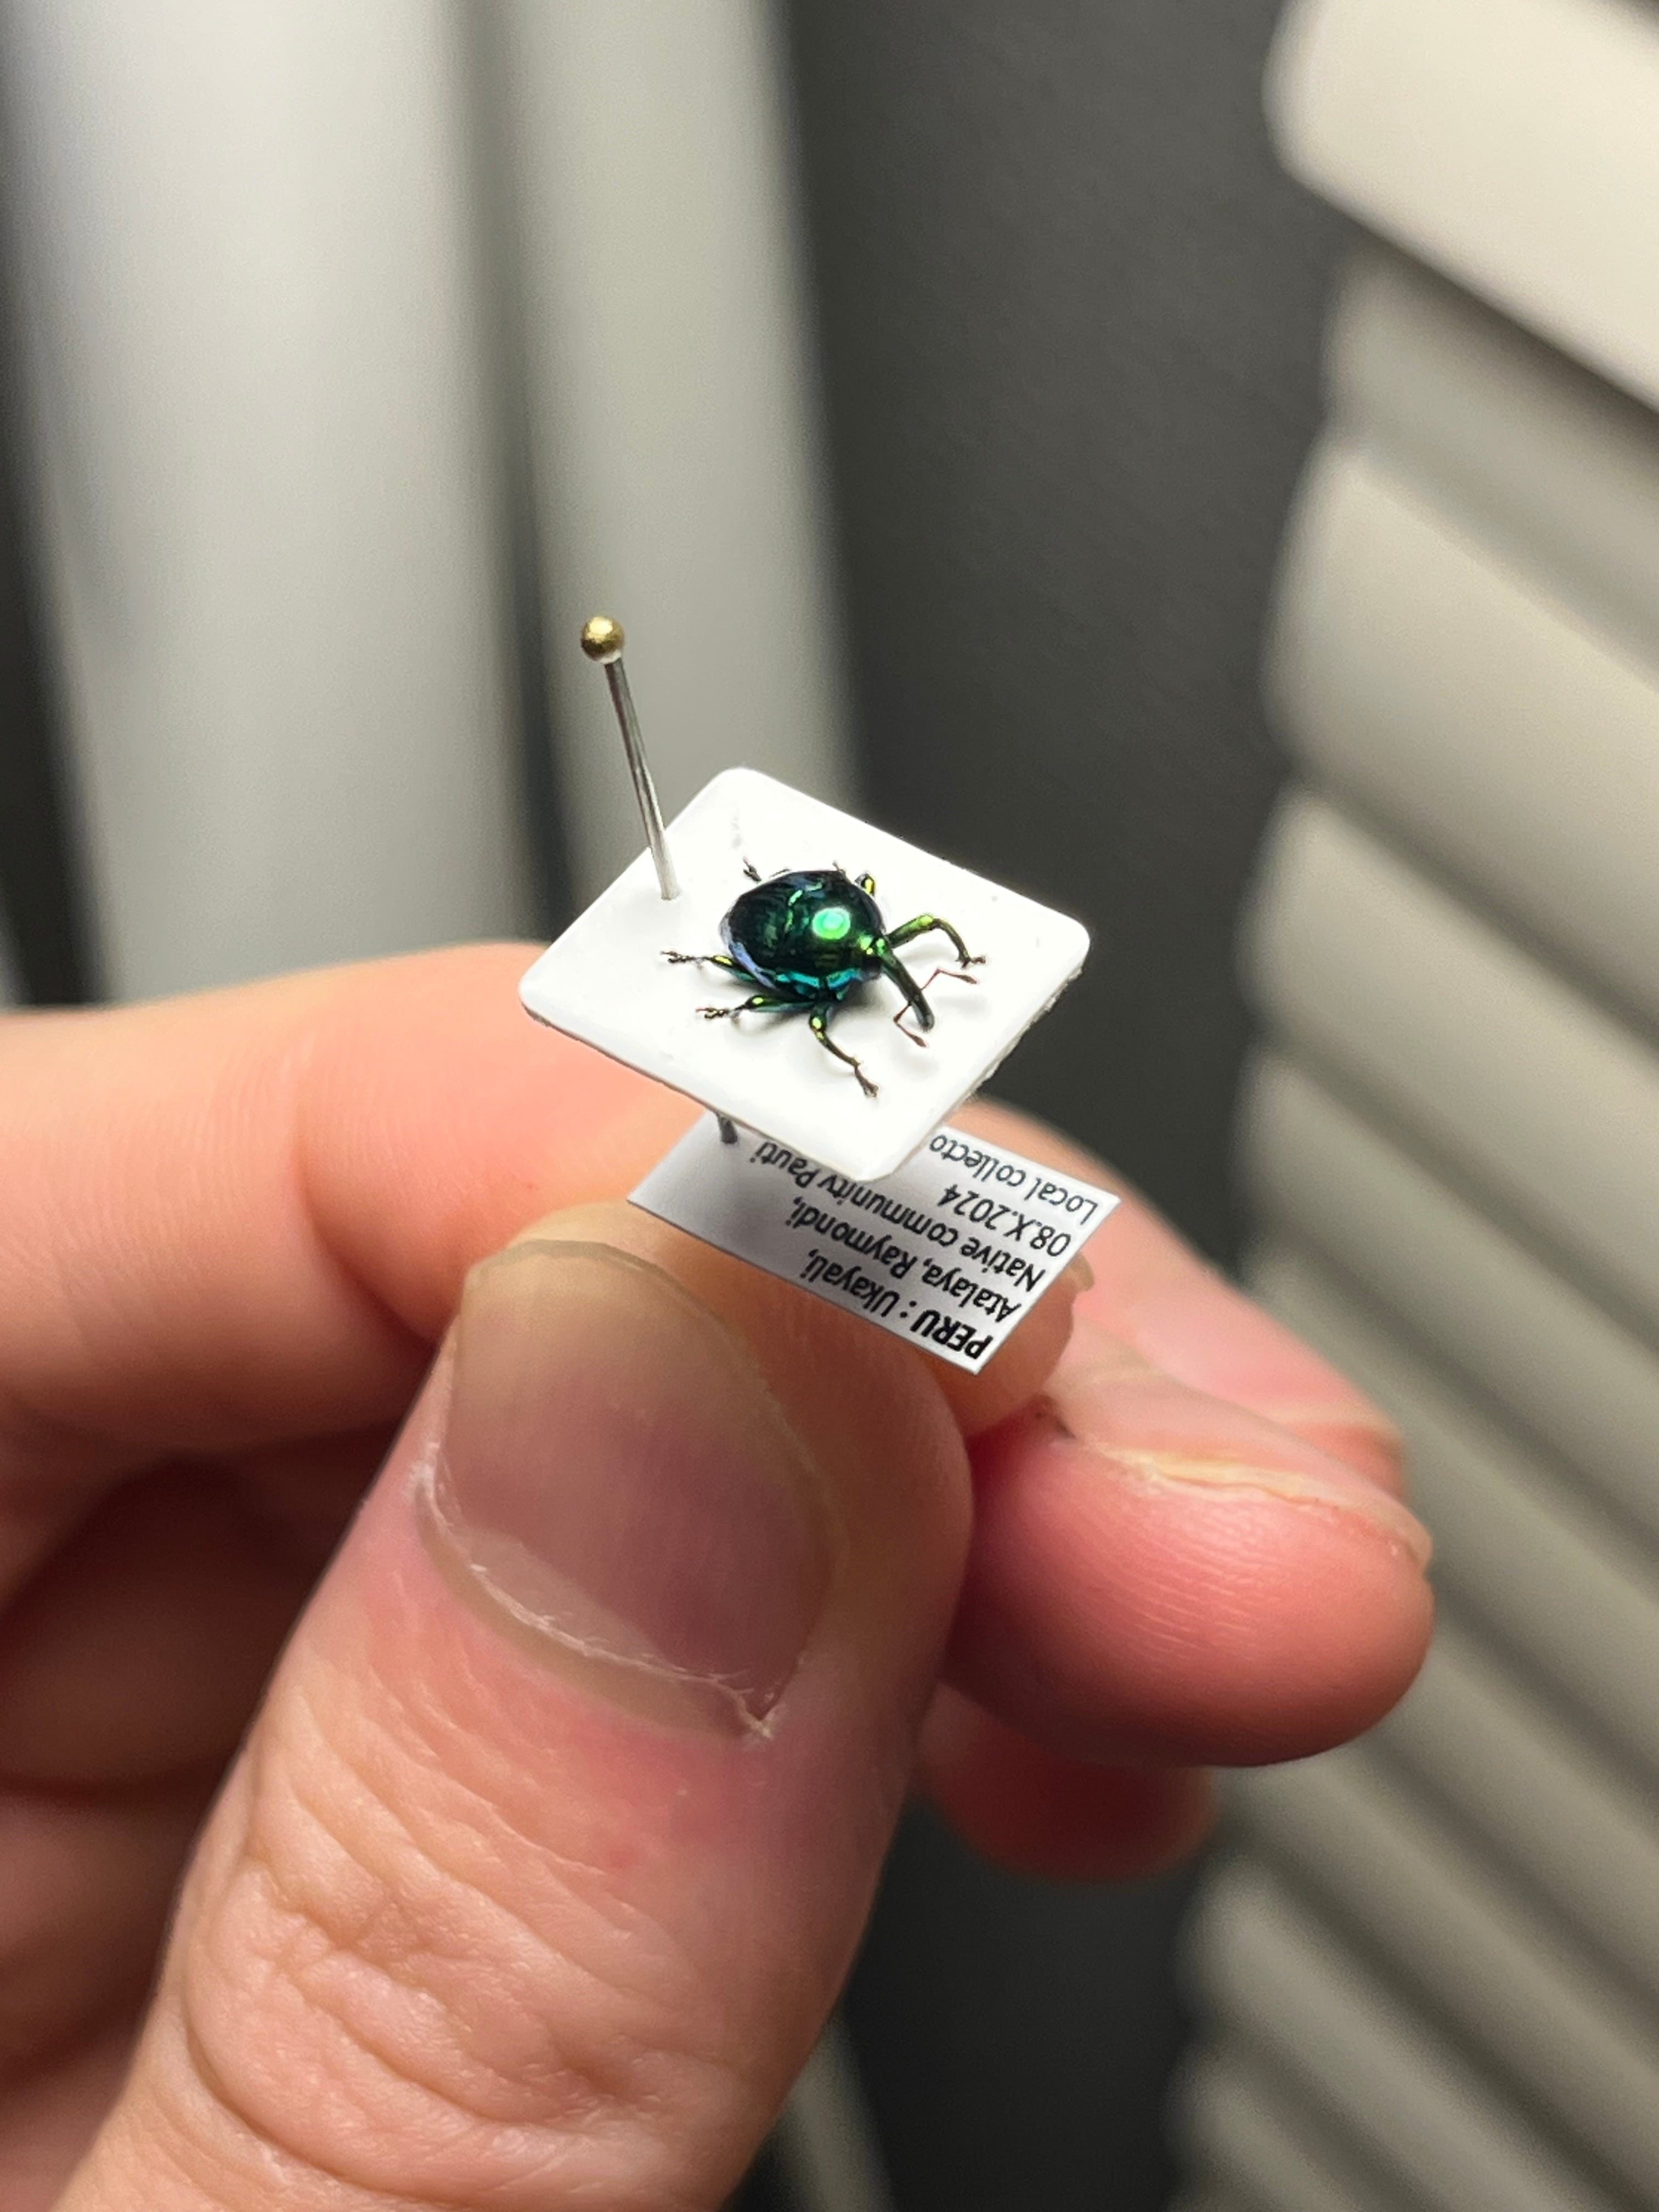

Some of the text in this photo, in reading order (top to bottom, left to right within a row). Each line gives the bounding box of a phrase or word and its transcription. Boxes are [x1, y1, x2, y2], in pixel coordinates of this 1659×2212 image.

[749, 1142, 1046, 1293] Native community Pauti
[938, 1183, 1071, 1256] 08.X.2024
[1024, 1177, 1097, 1226] Local
[785, 1197, 1022, 1324] Atalaya, Raymondi,
[800, 1248, 900, 1318] Ukayali,
[911, 1308, 992, 1360] PERU
